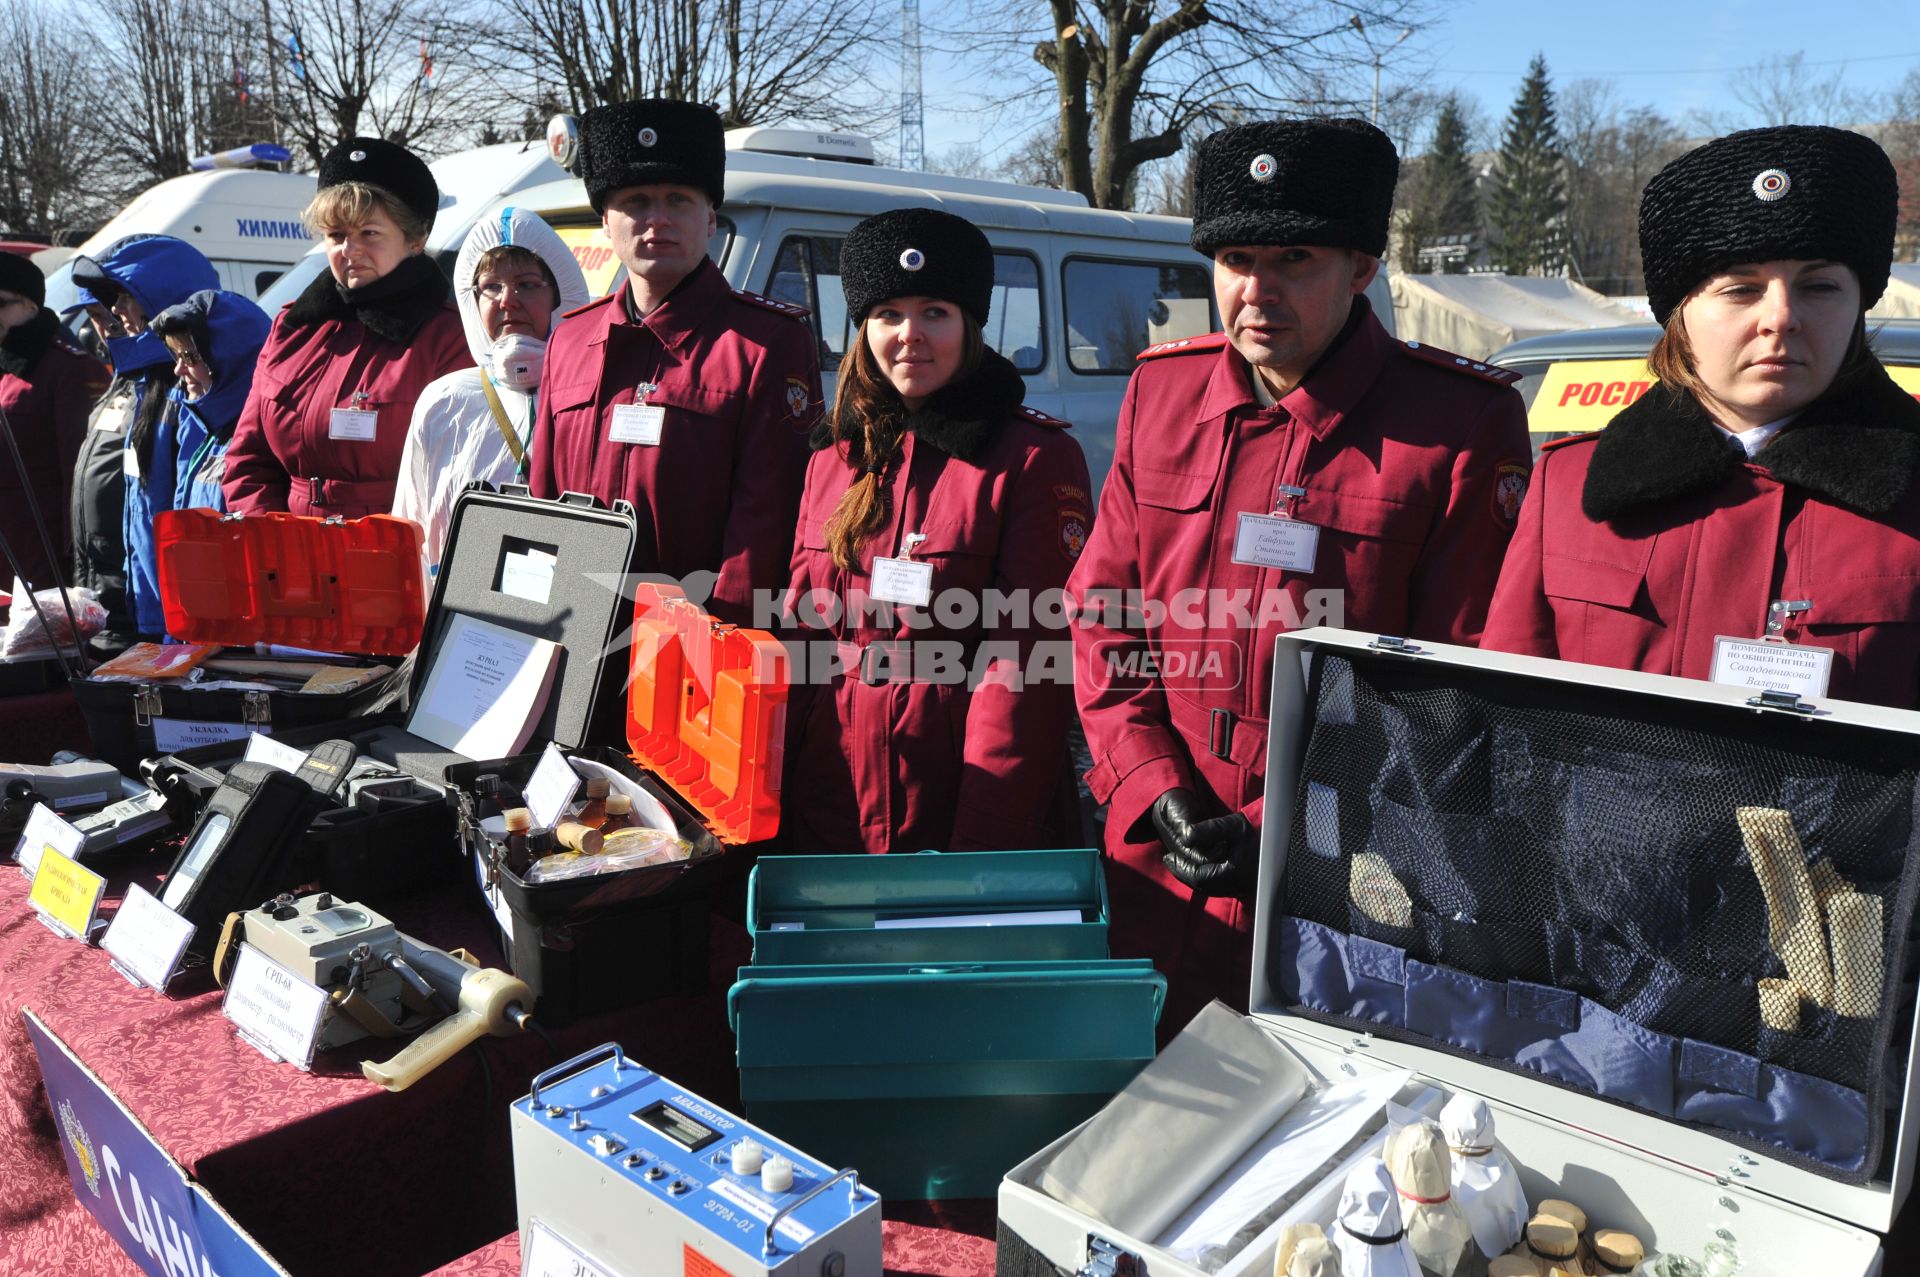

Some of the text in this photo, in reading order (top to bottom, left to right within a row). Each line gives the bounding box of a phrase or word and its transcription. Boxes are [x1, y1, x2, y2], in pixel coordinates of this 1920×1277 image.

[516, 366, 528, 374] 3M
[1244, 517, 1315, 532] НАЧАЛЬНИК БРИГАДЫ
[1254, 544, 1297, 557] Станислав
[1252, 554, 1295, 567] Романович
[1727, 651, 1817, 669] ПО ОБЩЕЙ ГИГИЕНЕ
[1730, 643, 1816, 660] ПОМОЩНИК ВРАЧА
[1729, 661, 1812, 680] Солодовникова
[1745, 676, 1791, 690] Валерия
[189, 725, 229, 734] УКЛАДКА
[265, 966, 293, 991] СРП-68
[255, 983, 291, 1013] поисковый
[233, 989, 263, 1018] дозиметр
[266, 1012, 304, 1044] радиометр
[670, 1094, 735, 1130] АНАЛИЗАТОР
[703, 1199, 755, 1234] ЭГРА-01
